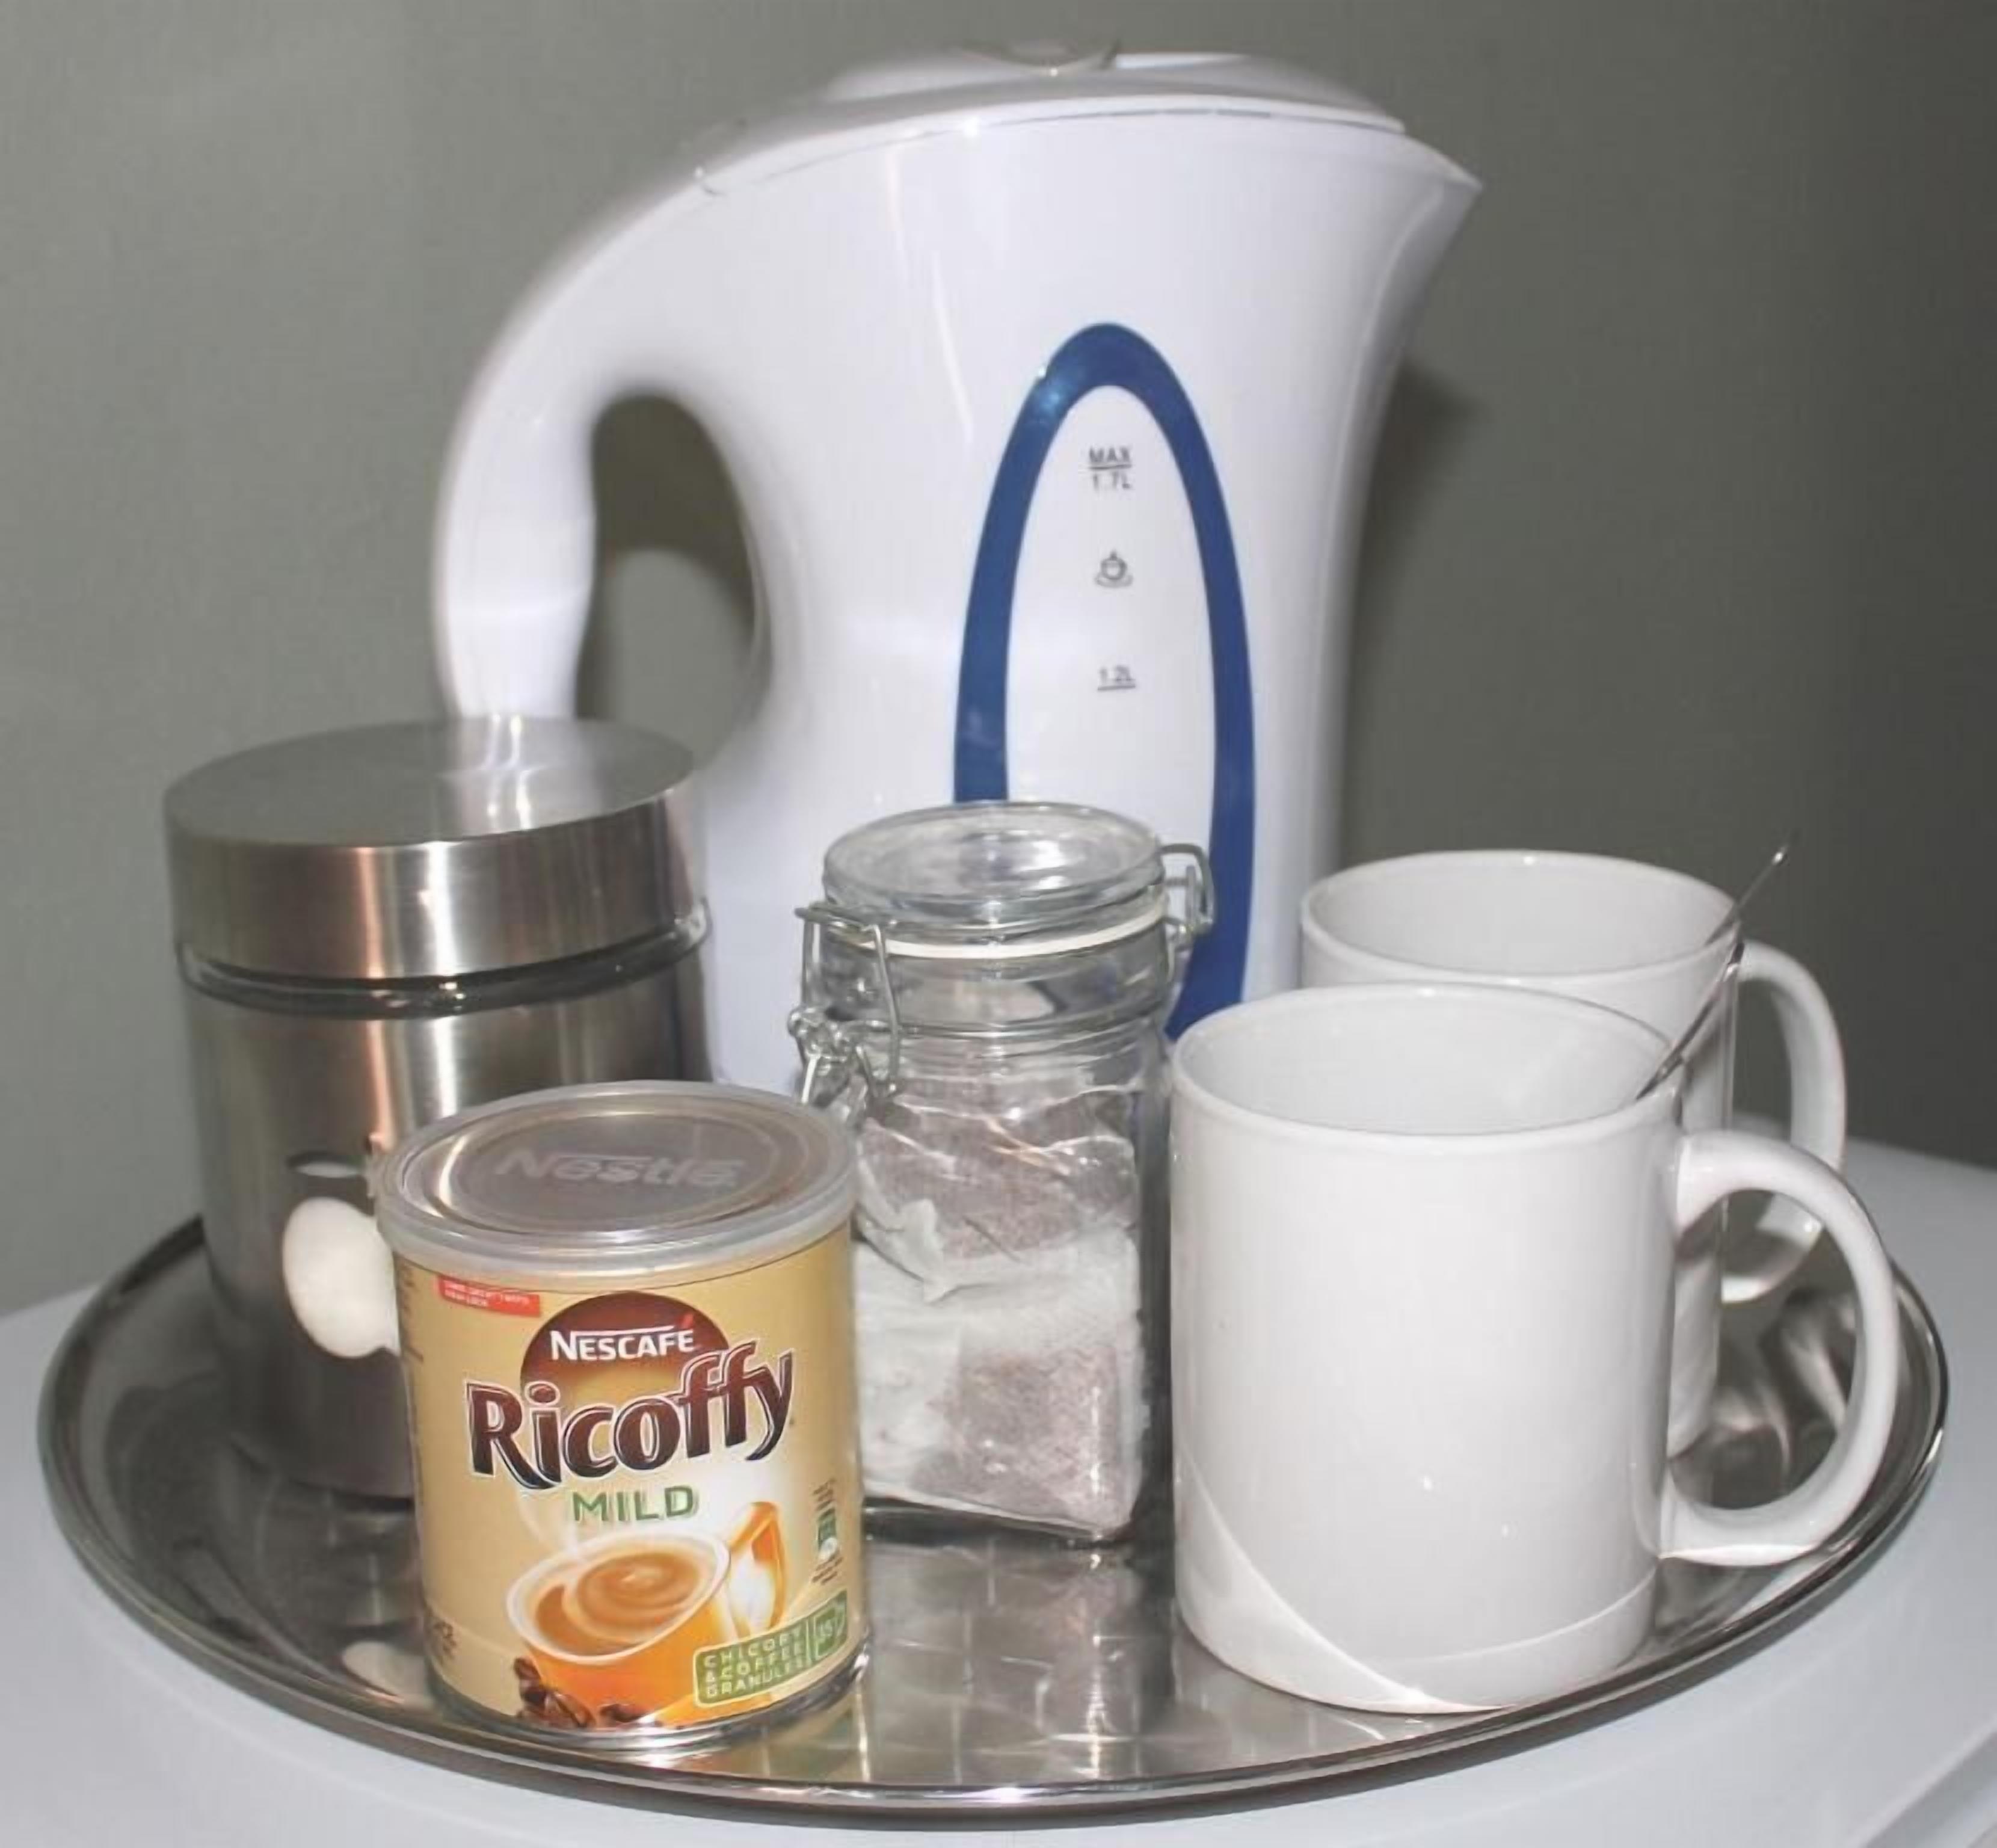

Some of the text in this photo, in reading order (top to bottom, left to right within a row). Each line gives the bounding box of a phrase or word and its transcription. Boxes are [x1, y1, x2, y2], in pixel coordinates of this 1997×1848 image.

[1089, 445, 1132, 463] MAX
[550, 1314, 696, 1361] NESCAFÉ
[465, 1339, 794, 1491] Ricoffy
[573, 1485, 698, 1522] MILD
